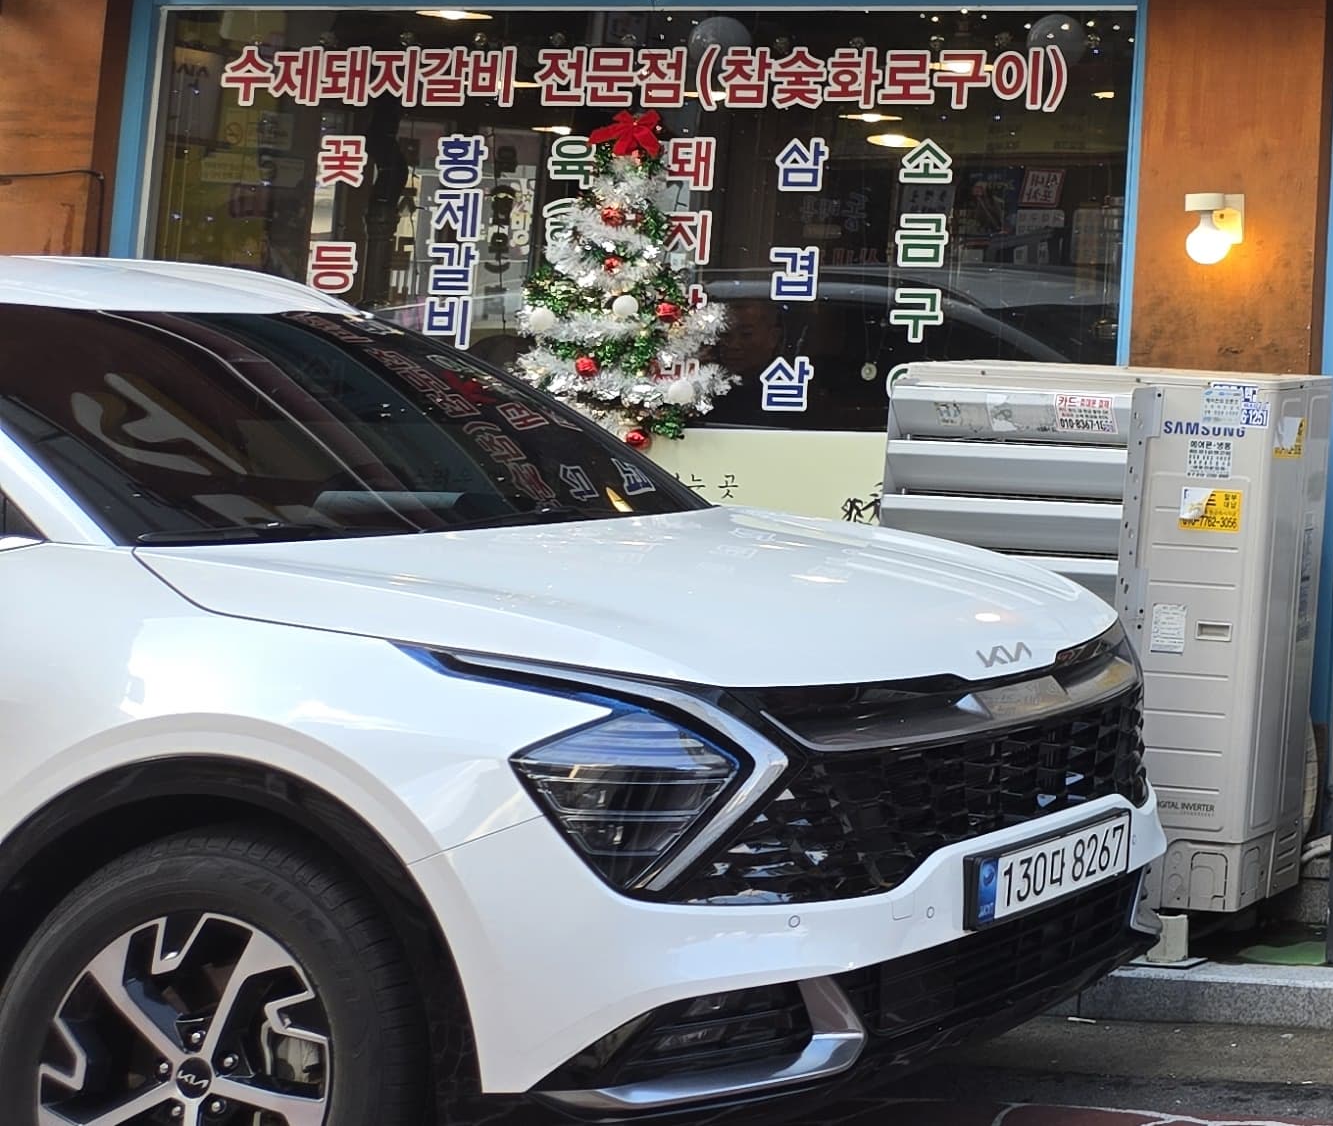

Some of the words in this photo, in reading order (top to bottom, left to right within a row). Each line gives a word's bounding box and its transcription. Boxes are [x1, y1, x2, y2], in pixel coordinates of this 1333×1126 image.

[221, 46, 517, 108] 수제돼지갈비
[534, 46, 688, 108] 전문점
[697, 46, 1068, 113] (참숯화로구이)
[1163, 420, 1246, 438] SAMSUNG
[1072, 824, 1126, 882] 8267
